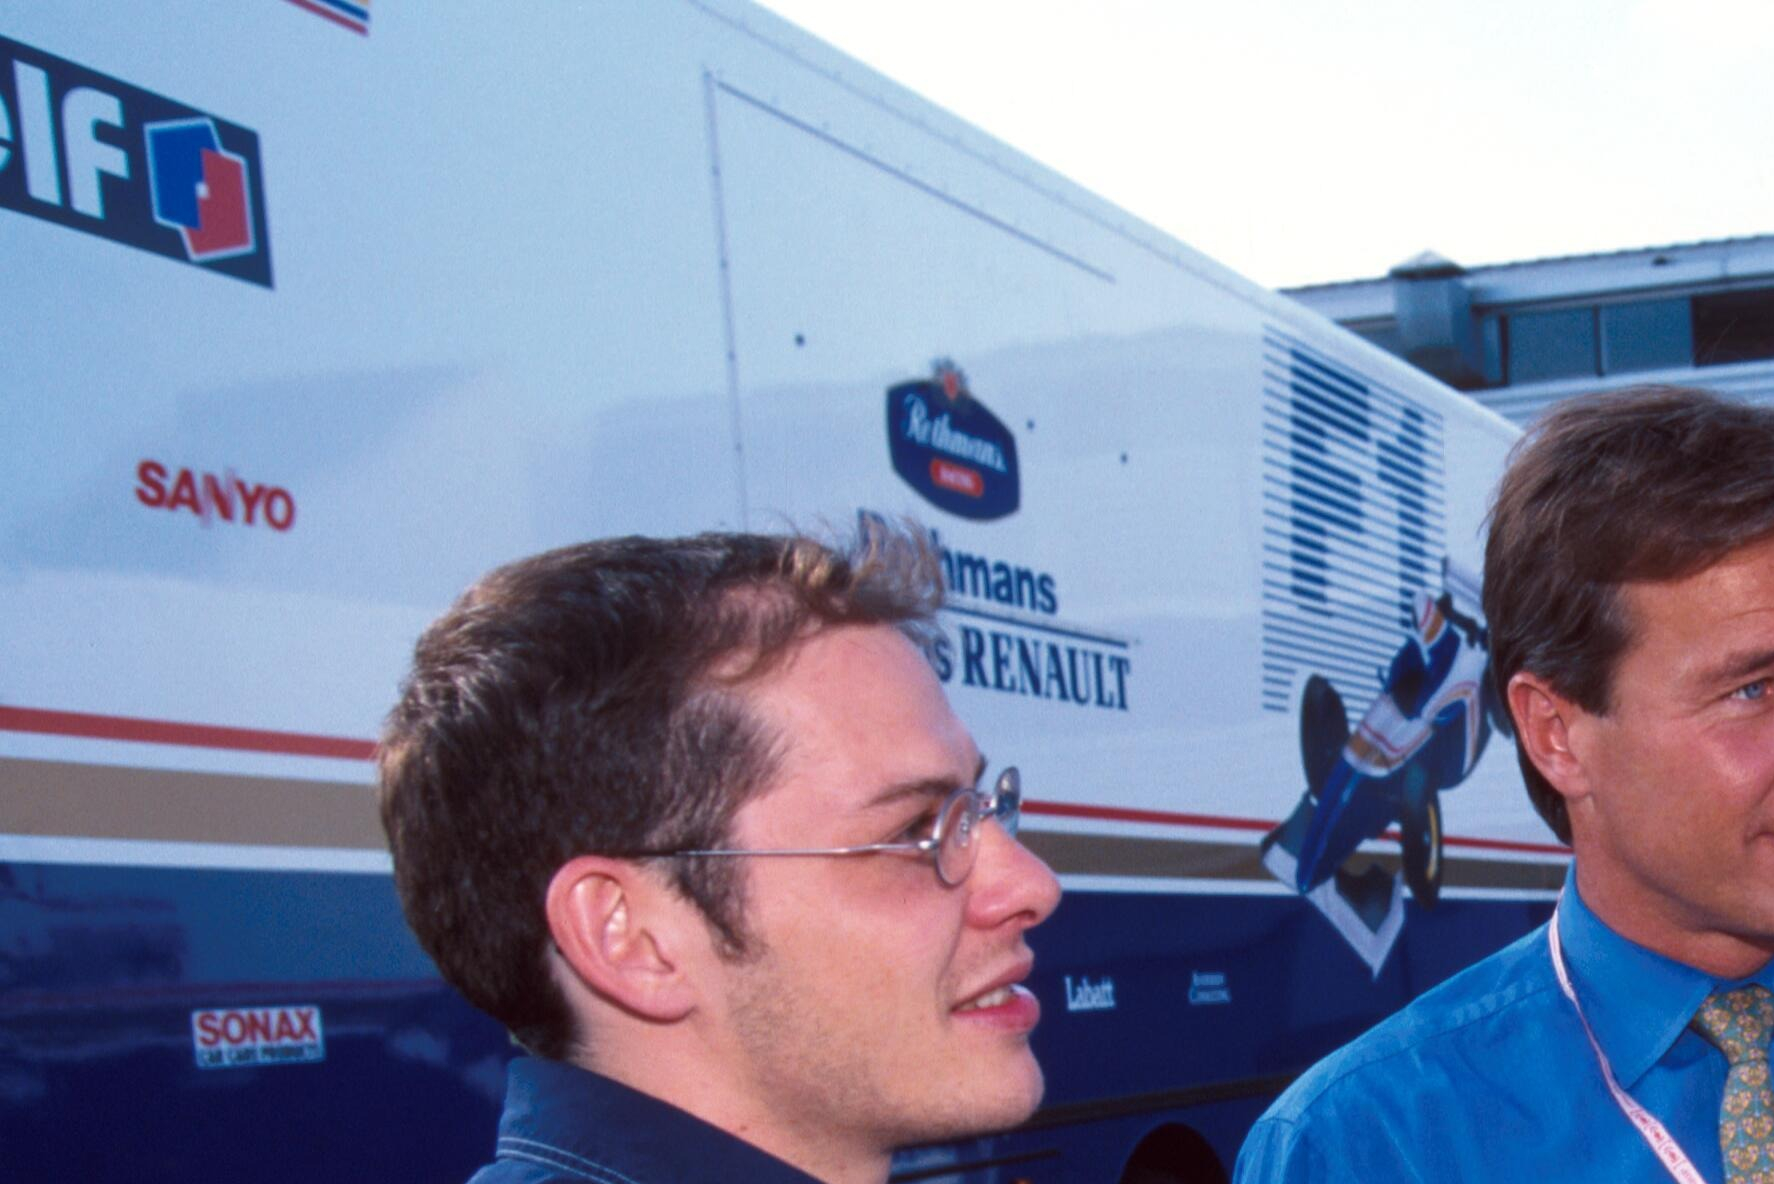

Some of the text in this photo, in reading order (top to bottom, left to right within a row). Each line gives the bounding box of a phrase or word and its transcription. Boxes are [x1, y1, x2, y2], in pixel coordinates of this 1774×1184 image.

[135, 459, 295, 533] SANYO
[960, 624, 1130, 711] RENAULT
[197, 1008, 317, 1045] SONAX
